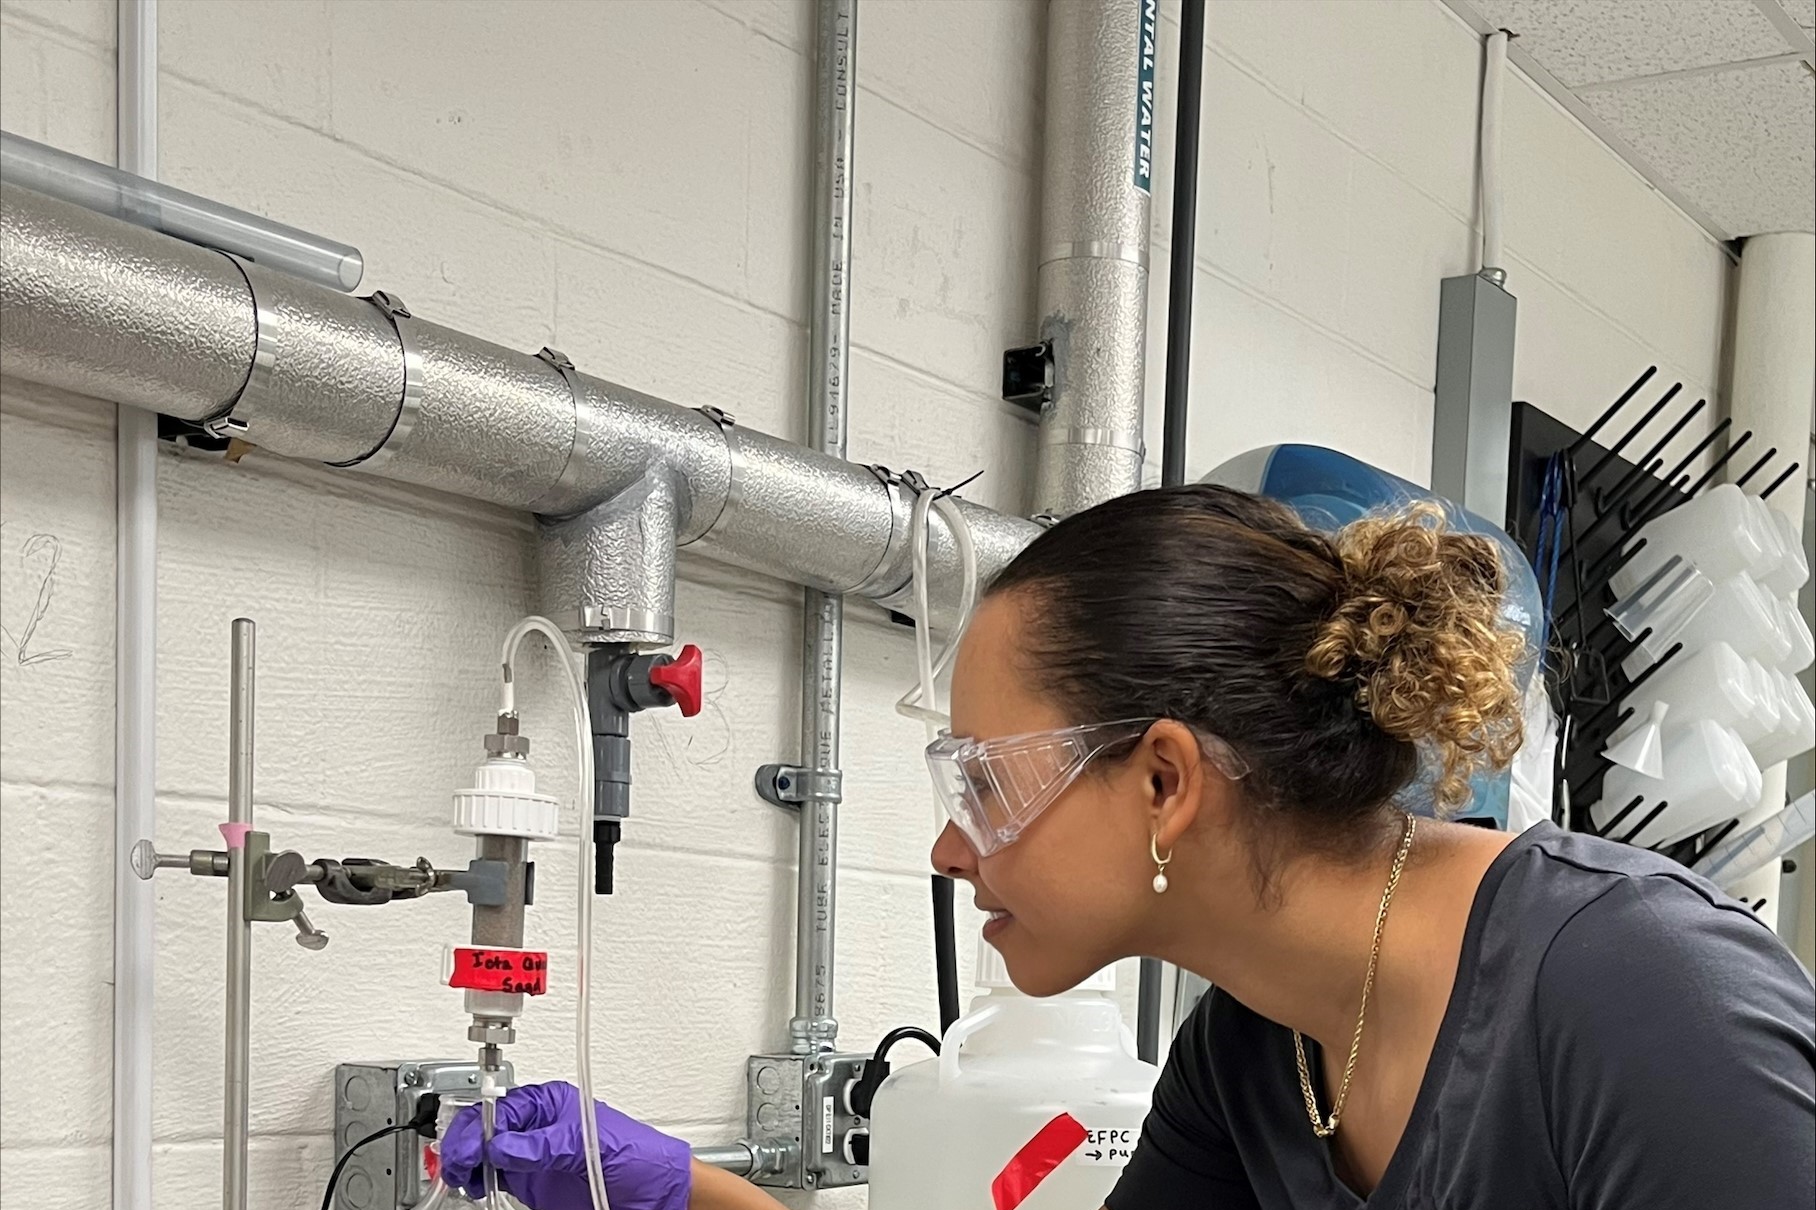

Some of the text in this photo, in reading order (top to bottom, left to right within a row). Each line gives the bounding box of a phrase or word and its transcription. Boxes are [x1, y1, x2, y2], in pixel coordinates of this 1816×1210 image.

[836, 12, 850, 111] CONSULT
[1138, 81, 1153, 178] WATER
[834, 157, 846, 199] USA
[833, 216, 843, 241] IN
[831, 259, 843, 315] MADE
[1087, 1130, 1130, 1145] EFPC
